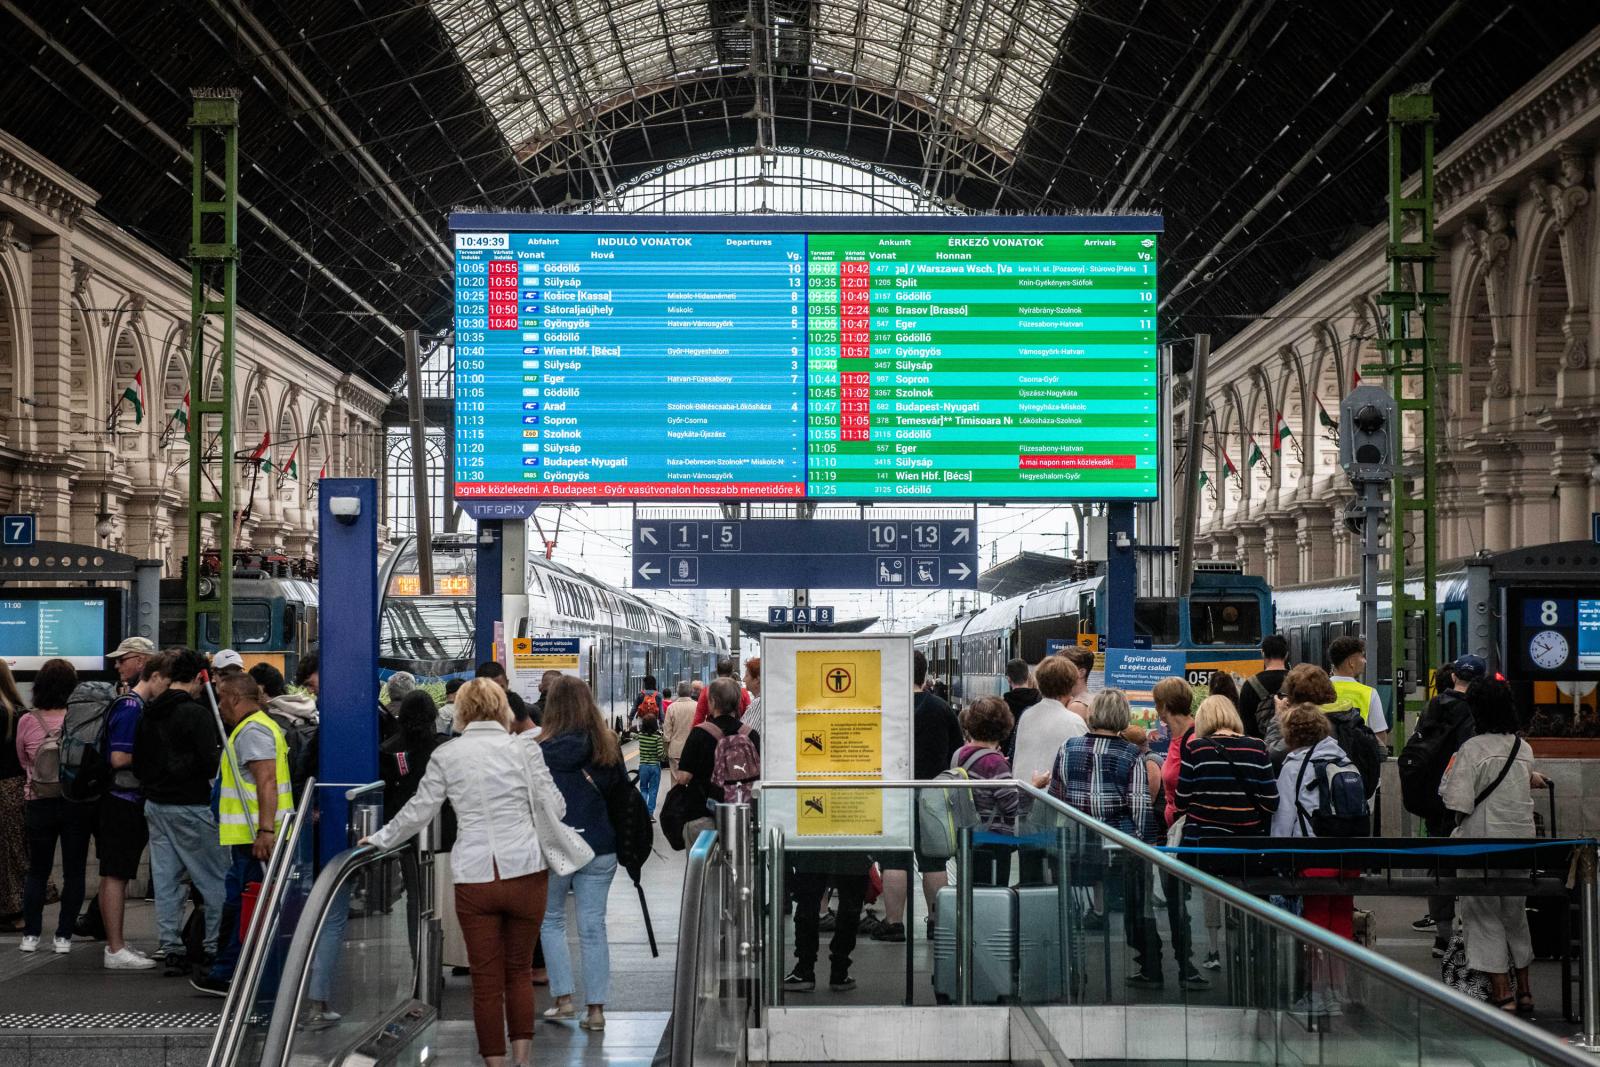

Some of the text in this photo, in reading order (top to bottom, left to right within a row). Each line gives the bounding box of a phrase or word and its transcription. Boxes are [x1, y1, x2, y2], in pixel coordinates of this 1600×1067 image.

[461, 237, 505, 246] 10:49:39
[598, 236, 692, 246] INDULÓ VONATOK
[726, 238, 772, 247] Departures
[948, 237, 989, 246] ÉRKEZŐ
[591, 251, 614, 259] Hová
[787, 252, 802, 260] Vg.
[1138, 252, 1153, 260] Vg.
[458, 264, 484, 273] 10:05
[490, 264, 517, 273] 10:55
[544, 263, 580, 273] Gödöllő
[789, 264, 801, 273] 10
[841, 264, 869, 273] 10:42
[917, 264, 964, 273] Warszawa
[966, 264, 994, 273] Wsch.
[1143, 265, 1148, 273] 1
[458, 278, 484, 286] 10:20
[490, 278, 517, 286] 10:50
[544, 277, 581, 288] Sülysáp
[789, 278, 801, 287] 13
[809, 278, 917, 289] 09:35 12:01 Split
[458, 291, 484, 300] 10:25
[490, 291, 517, 300] 10:50
[791, 292, 798, 301] 8
[841, 291, 1152, 301] 10:49 Gödöllő 10
[458, 305, 484, 314] 10:25
[490, 305, 517, 314] 10:50
[544, 305, 613, 316] Sátoraljaújhely
[791, 306, 798, 314] 8
[809, 306, 836, 315] 09:55
[841, 306, 869, 315] 12:24
[895, 305, 928, 315] Brasov
[930, 305, 968, 316] [Brassó]
[458, 318, 798, 330] 10:30 10:40 Gyöngyös 5
[841, 319, 1151, 330] 10:47 Eger 11
[458, 333, 484, 342] 10:35
[544, 332, 580, 342] Gödöllő
[809, 333, 931, 342] 10:25 11:02 Gödöllő
[458, 346, 798, 356] 10:40 Wien Hbf. [Bécs] 9
[809, 347, 941, 358] 10:35 10:57 Gyöngyös
[458, 360, 484, 369] 10:50
[544, 360, 581, 371] Sülysáp
[791, 361, 798, 370] 3
[895, 360, 933, 371] Sülysáp
[458, 374, 798, 385] 11:00 Eger 7
[809, 374, 929, 385] 10:44 11:02 Sopron
[458, 388, 484, 397] 11:05
[544, 388, 580, 397] Gödöllő
[809, 388, 933, 398] 10:45 11:02 Szolnok
[458, 401, 798, 411] 11:10 Arad 4
[809, 402, 980, 413] 10:47 11:31 Budapest-Nyugati
[458, 416, 484, 425] 11:13
[544, 416, 577, 426] Sopron
[809, 416, 836, 425] 10:50
[841, 416, 869, 425] 11:05
[956, 416, 1001, 425] Timisoara
[458, 429, 581, 439] 11:15 Szolnok
[809, 430, 931, 439] 10:55 11:18 Gödöllő
[458, 444, 484, 452] 11:20
[544, 443, 581, 454] Sülysáp
[809, 444, 1083, 454] 11:05 Eger Füzesabony-Hatvan
[458, 457, 628, 468] 11:25 Budapest-Nyugati
[809, 458, 836, 466] 11:10
[895, 457, 933, 468] Sülysáp
[458, 471, 589, 482] 11:30 Gyöngyös
[809, 471, 1081, 482] 11:19 Wien Hbf. [Bécs] Hegyeshalom-Győr
[553, 486, 596, 495] Budapest
[604, 486, 625, 495] Győr
[629, 486, 690, 494] vasútvonalon
[694, 486, 738, 494] hosszabb
[741, 486, 792, 494] menetidőre
[809, 485, 931, 494] 11:25 Gödöllő
[474, 505, 524, 514] INFOPIX
[11, 522, 25, 540] 7
[679, 526, 733, 543] 1 5
[872, 526, 938, 543] 10 13
[775, 610, 781, 619] 7
[797, 610, 806, 619] A
[822, 610, 828, 619] 8
[1541, 600, 1558, 626] 8
[1124, 655, 1145, 664] Együtt
